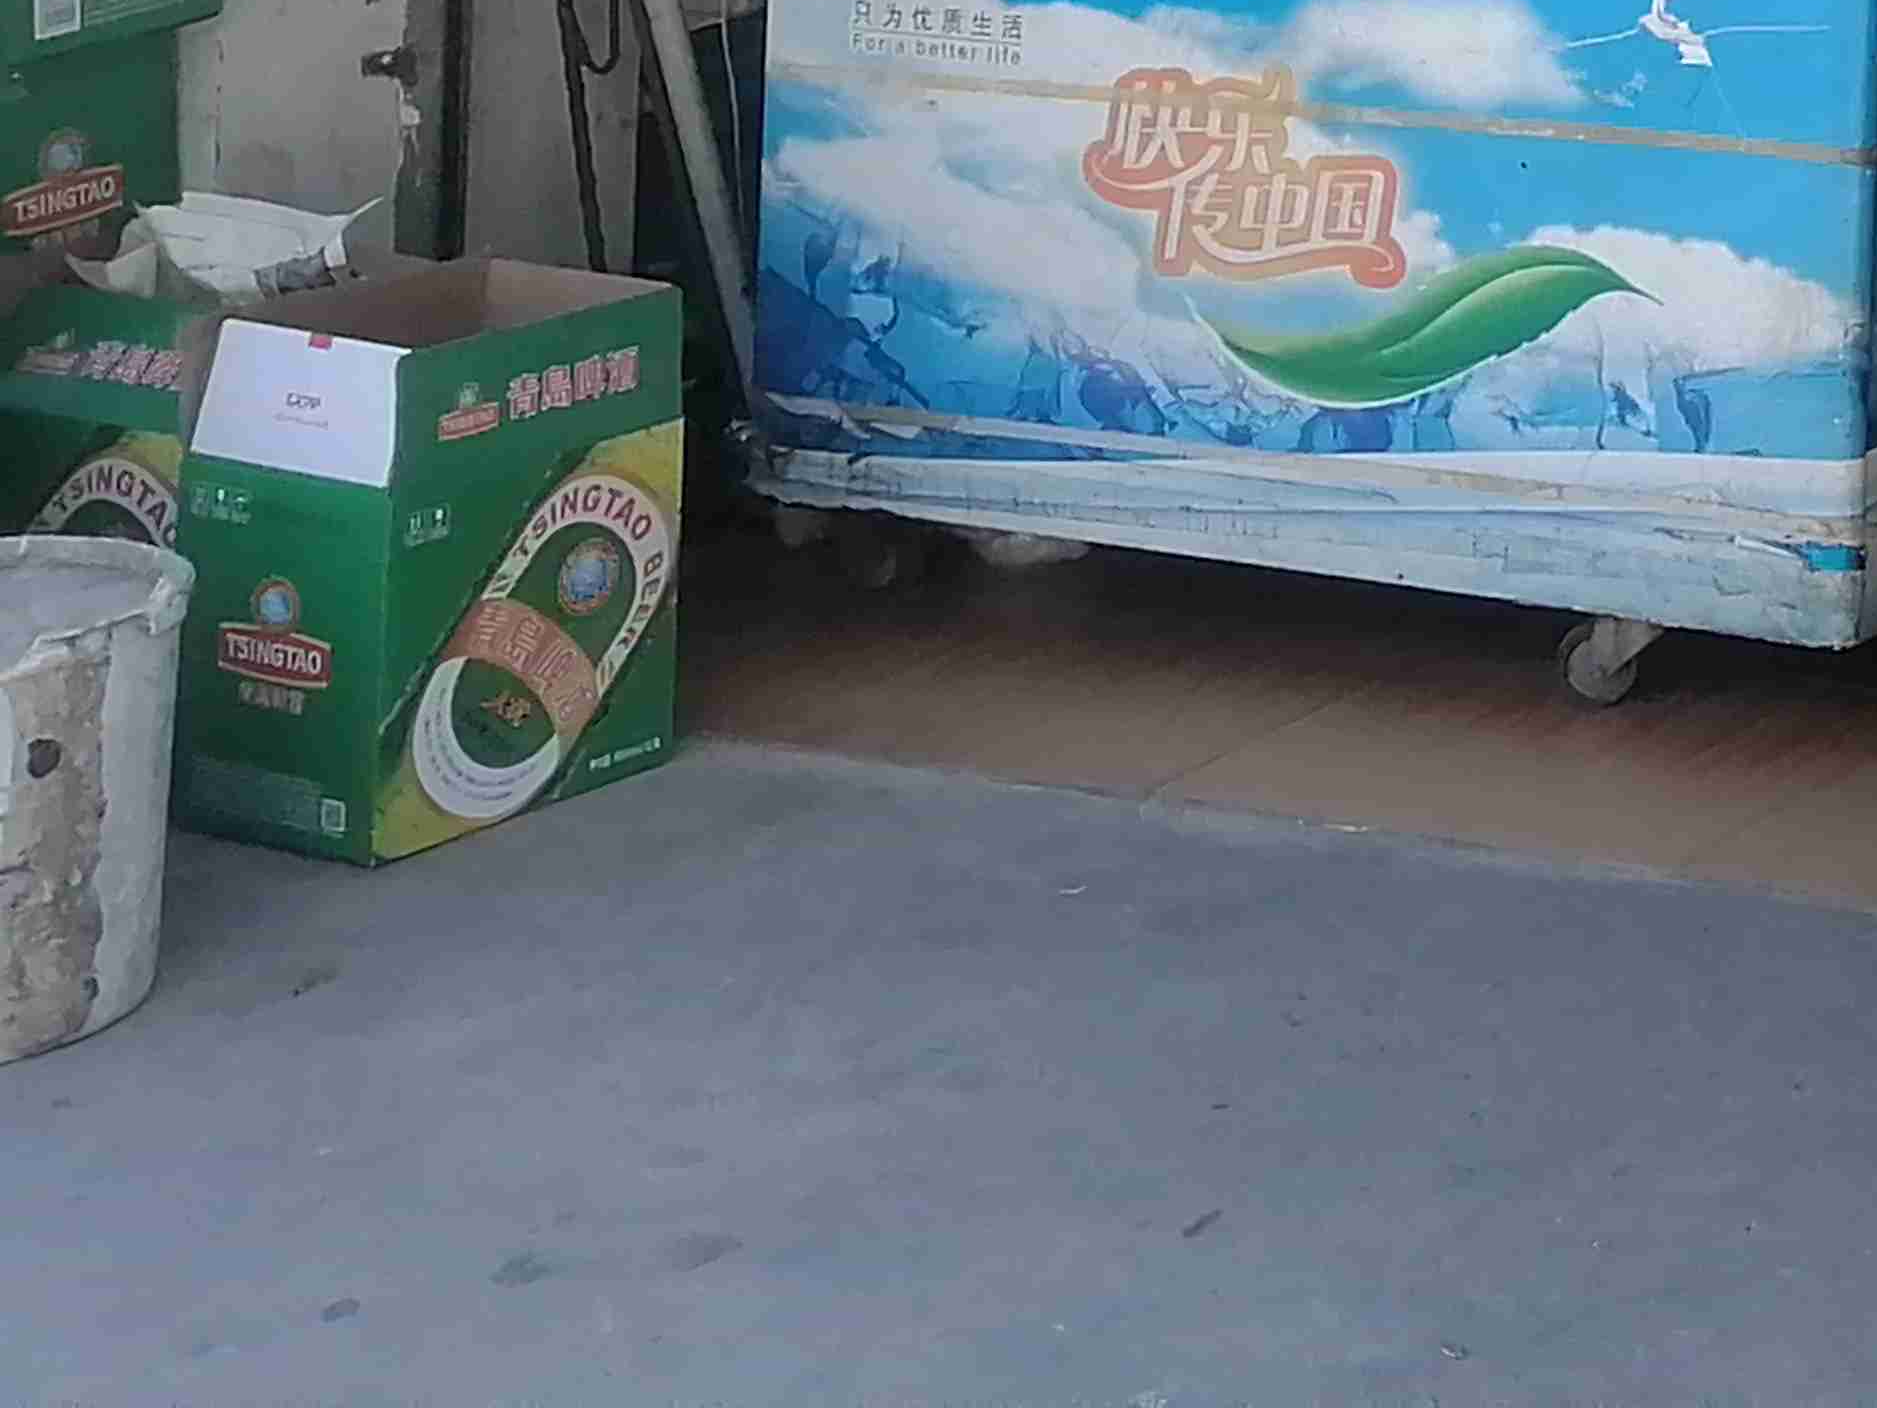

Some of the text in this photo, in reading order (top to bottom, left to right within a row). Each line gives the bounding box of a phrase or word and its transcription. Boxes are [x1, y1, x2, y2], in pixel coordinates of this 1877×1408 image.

[851, 0, 1023, 42] 只为优质生活
[852, 31, 885, 51] For
[916, 38, 976, 61] better
[986, 43, 1022, 66] life
[13, 174, 117, 223] TSINGTAO
[1160, 164, 1385, 272] 传中国
[512, 483, 653, 561] TSINGTAO
[225, 634, 323, 677] TSINGTAO
